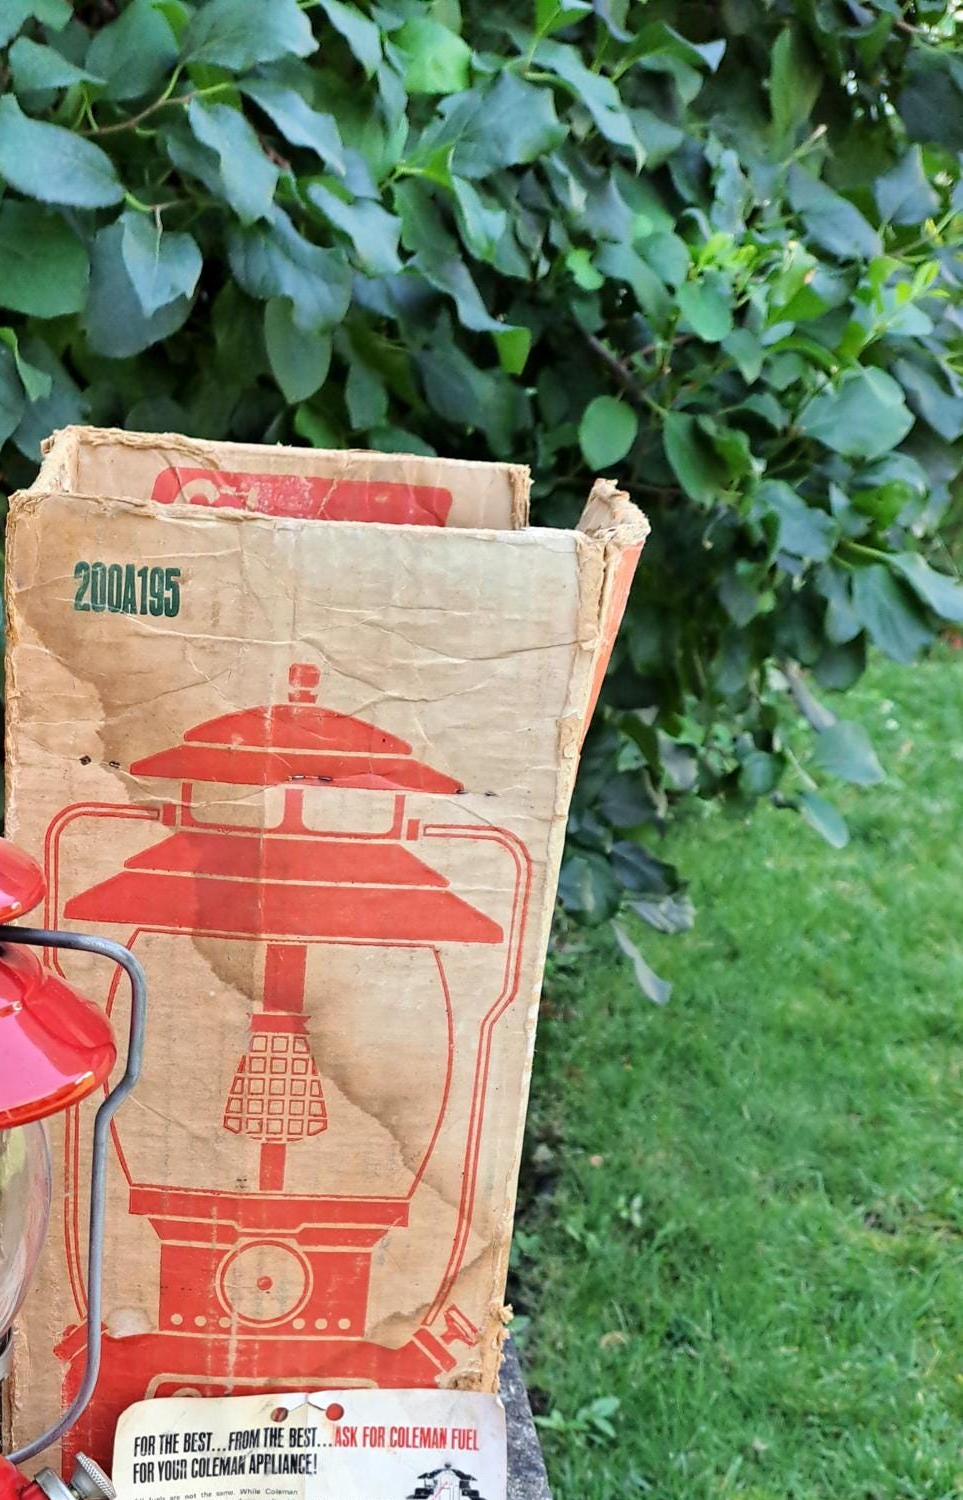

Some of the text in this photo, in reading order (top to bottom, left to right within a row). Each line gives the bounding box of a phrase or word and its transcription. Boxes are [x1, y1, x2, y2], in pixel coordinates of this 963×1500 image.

[74, 561, 181, 617] 200A195
[134, 1434, 156, 1457] FOR
[159, 1433, 180, 1455] THE
[228, 1428, 261, 1451] FROM
[263, 1427, 285, 1448] THE
[334, 1426, 357, 1448] ASK
[363, 1426, 386, 1448] FOR
[390, 1426, 447, 1449] COLEMAN
[451, 1428, 479, 1451] FUEL
[133, 1453, 317, 1484] FOR YOUR COLEMAN APPLIANCE!
